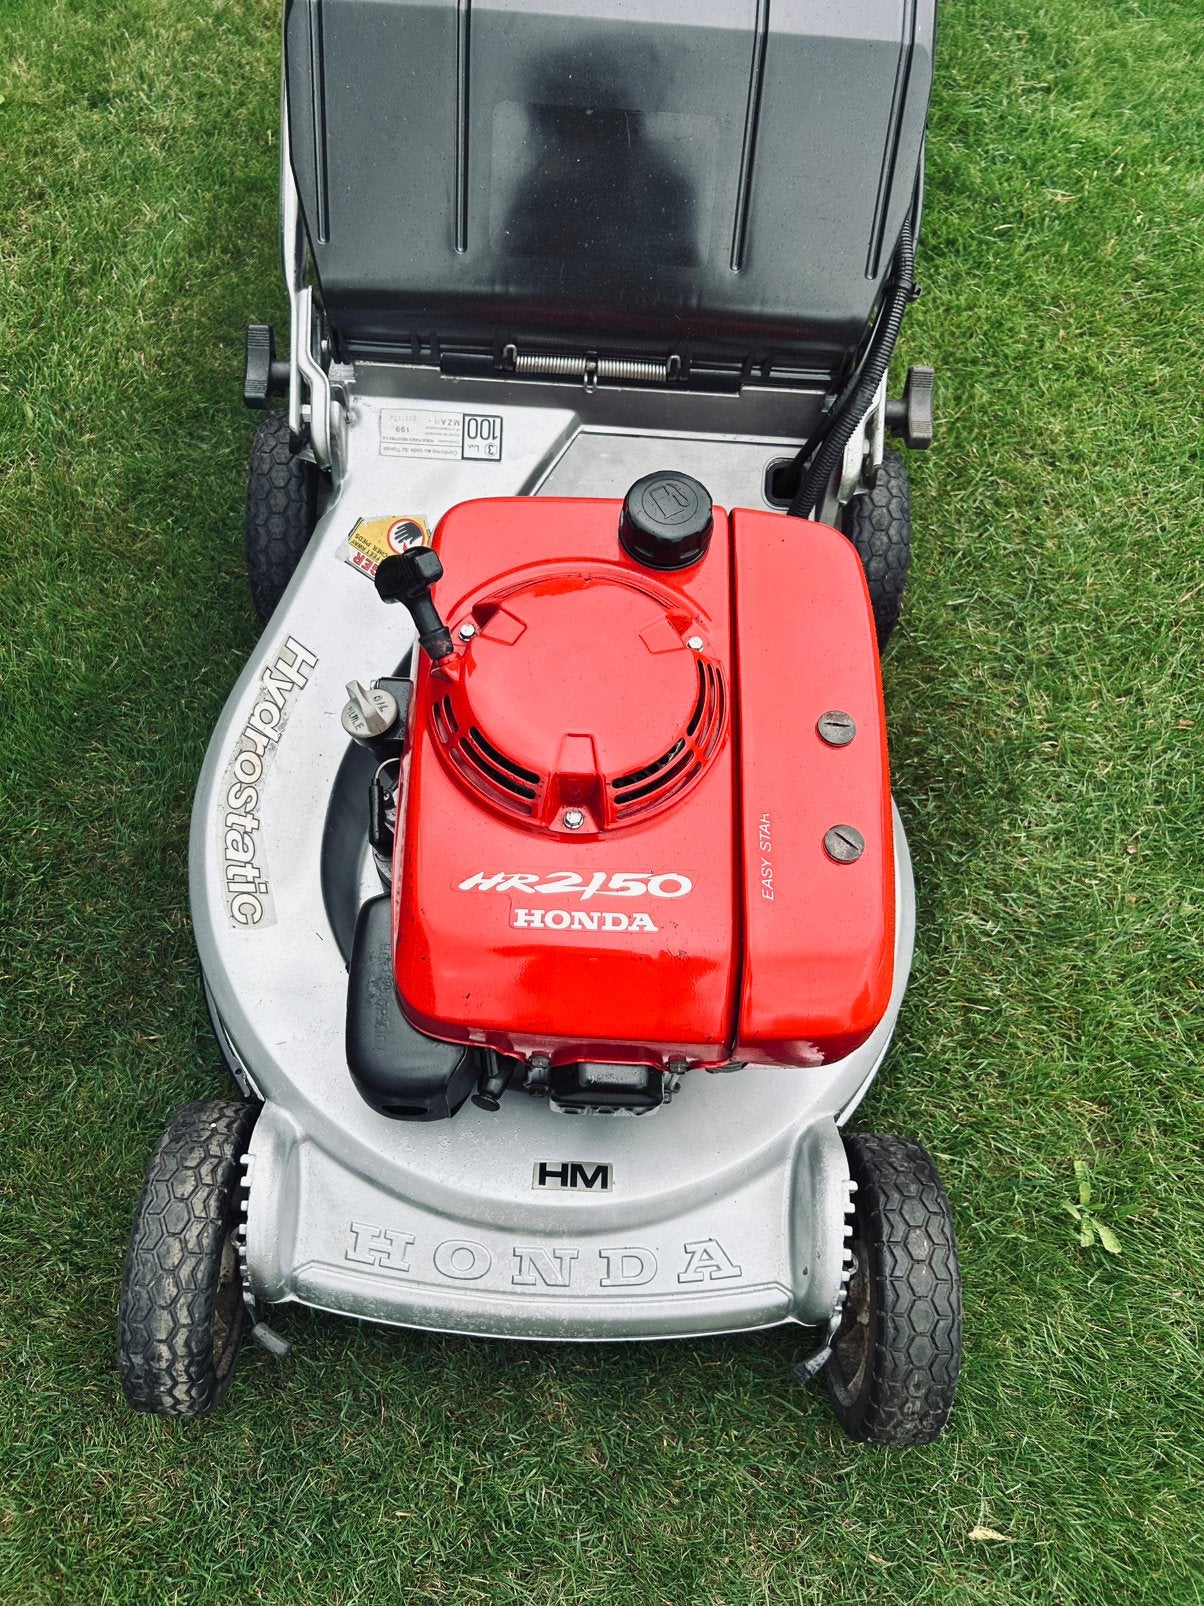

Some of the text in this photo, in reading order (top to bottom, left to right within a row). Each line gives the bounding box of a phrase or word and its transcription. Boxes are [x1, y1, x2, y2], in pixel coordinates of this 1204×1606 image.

[467, 417, 499, 441] 100
[487, 444, 495, 455] 3
[351, 539, 380, 562] FEET AWAY
[355, 533, 388, 558] CHER PIEDS
[352, 552, 379, 577] GER
[224, 635, 319, 926] Hydrostatic
[458, 870, 693, 901] HR2150
[761, 857, 774, 900] EASY
[513, 907, 659, 933] HONDA
[537, 1162, 609, 1190] HM
[344, 1220, 742, 1288] HONDA
